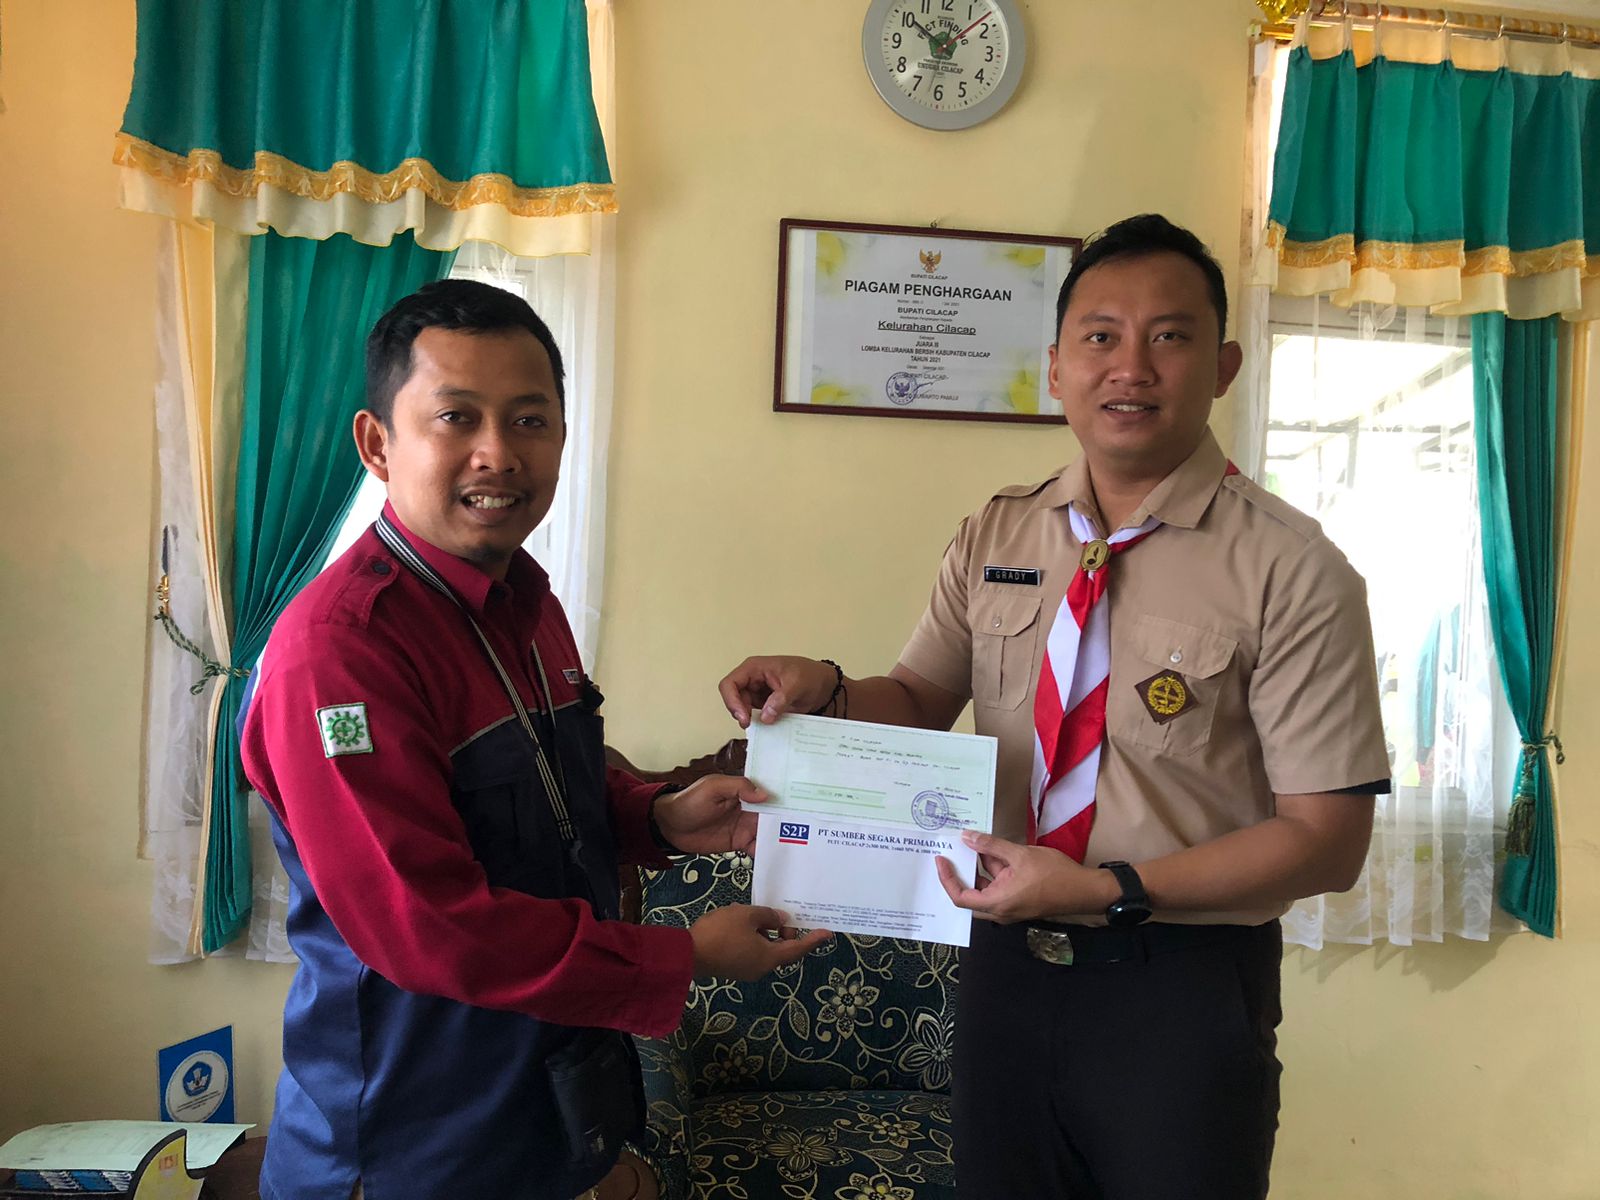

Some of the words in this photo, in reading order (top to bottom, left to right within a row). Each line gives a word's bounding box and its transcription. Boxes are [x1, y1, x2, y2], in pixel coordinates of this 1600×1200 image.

[942, 0, 954, 12] 12
[968, 5, 973, 20] 1
[902, 12, 915, 28] 10
[979, 23, 989, 39] 2
[892, 33, 902, 49] 9
[985, 46, 994, 62] 3
[897, 56, 907, 73] 8
[913, 75, 923, 91] 7
[975, 68, 985, 84] 4
[934, 85, 943, 101] 6
[958, 81, 967, 98] 5
[845, 279, 900, 294] PIAGAM
[904, 283, 1012, 301] PENGHARGAAN
[897, 307, 924, 315] BUPATI
[925, 308, 958, 317] CILACAP
[878, 320, 933, 333] Kelurahan
[936, 323, 977, 335] Cilacap
[881, 346, 914, 354] KELURAHAN
[935, 349, 967, 357] KABUPATEN
[995, 570, 1026, 581] GRADY
[781, 824, 807, 837] S2P
[818, 828, 829, 837] PT
[830, 829, 865, 841] SUMBER
[867, 833, 900, 844] SEGARA
[903, 837, 953, 850] PRIMADAYA
[841, 840, 865, 848] CILACAP
